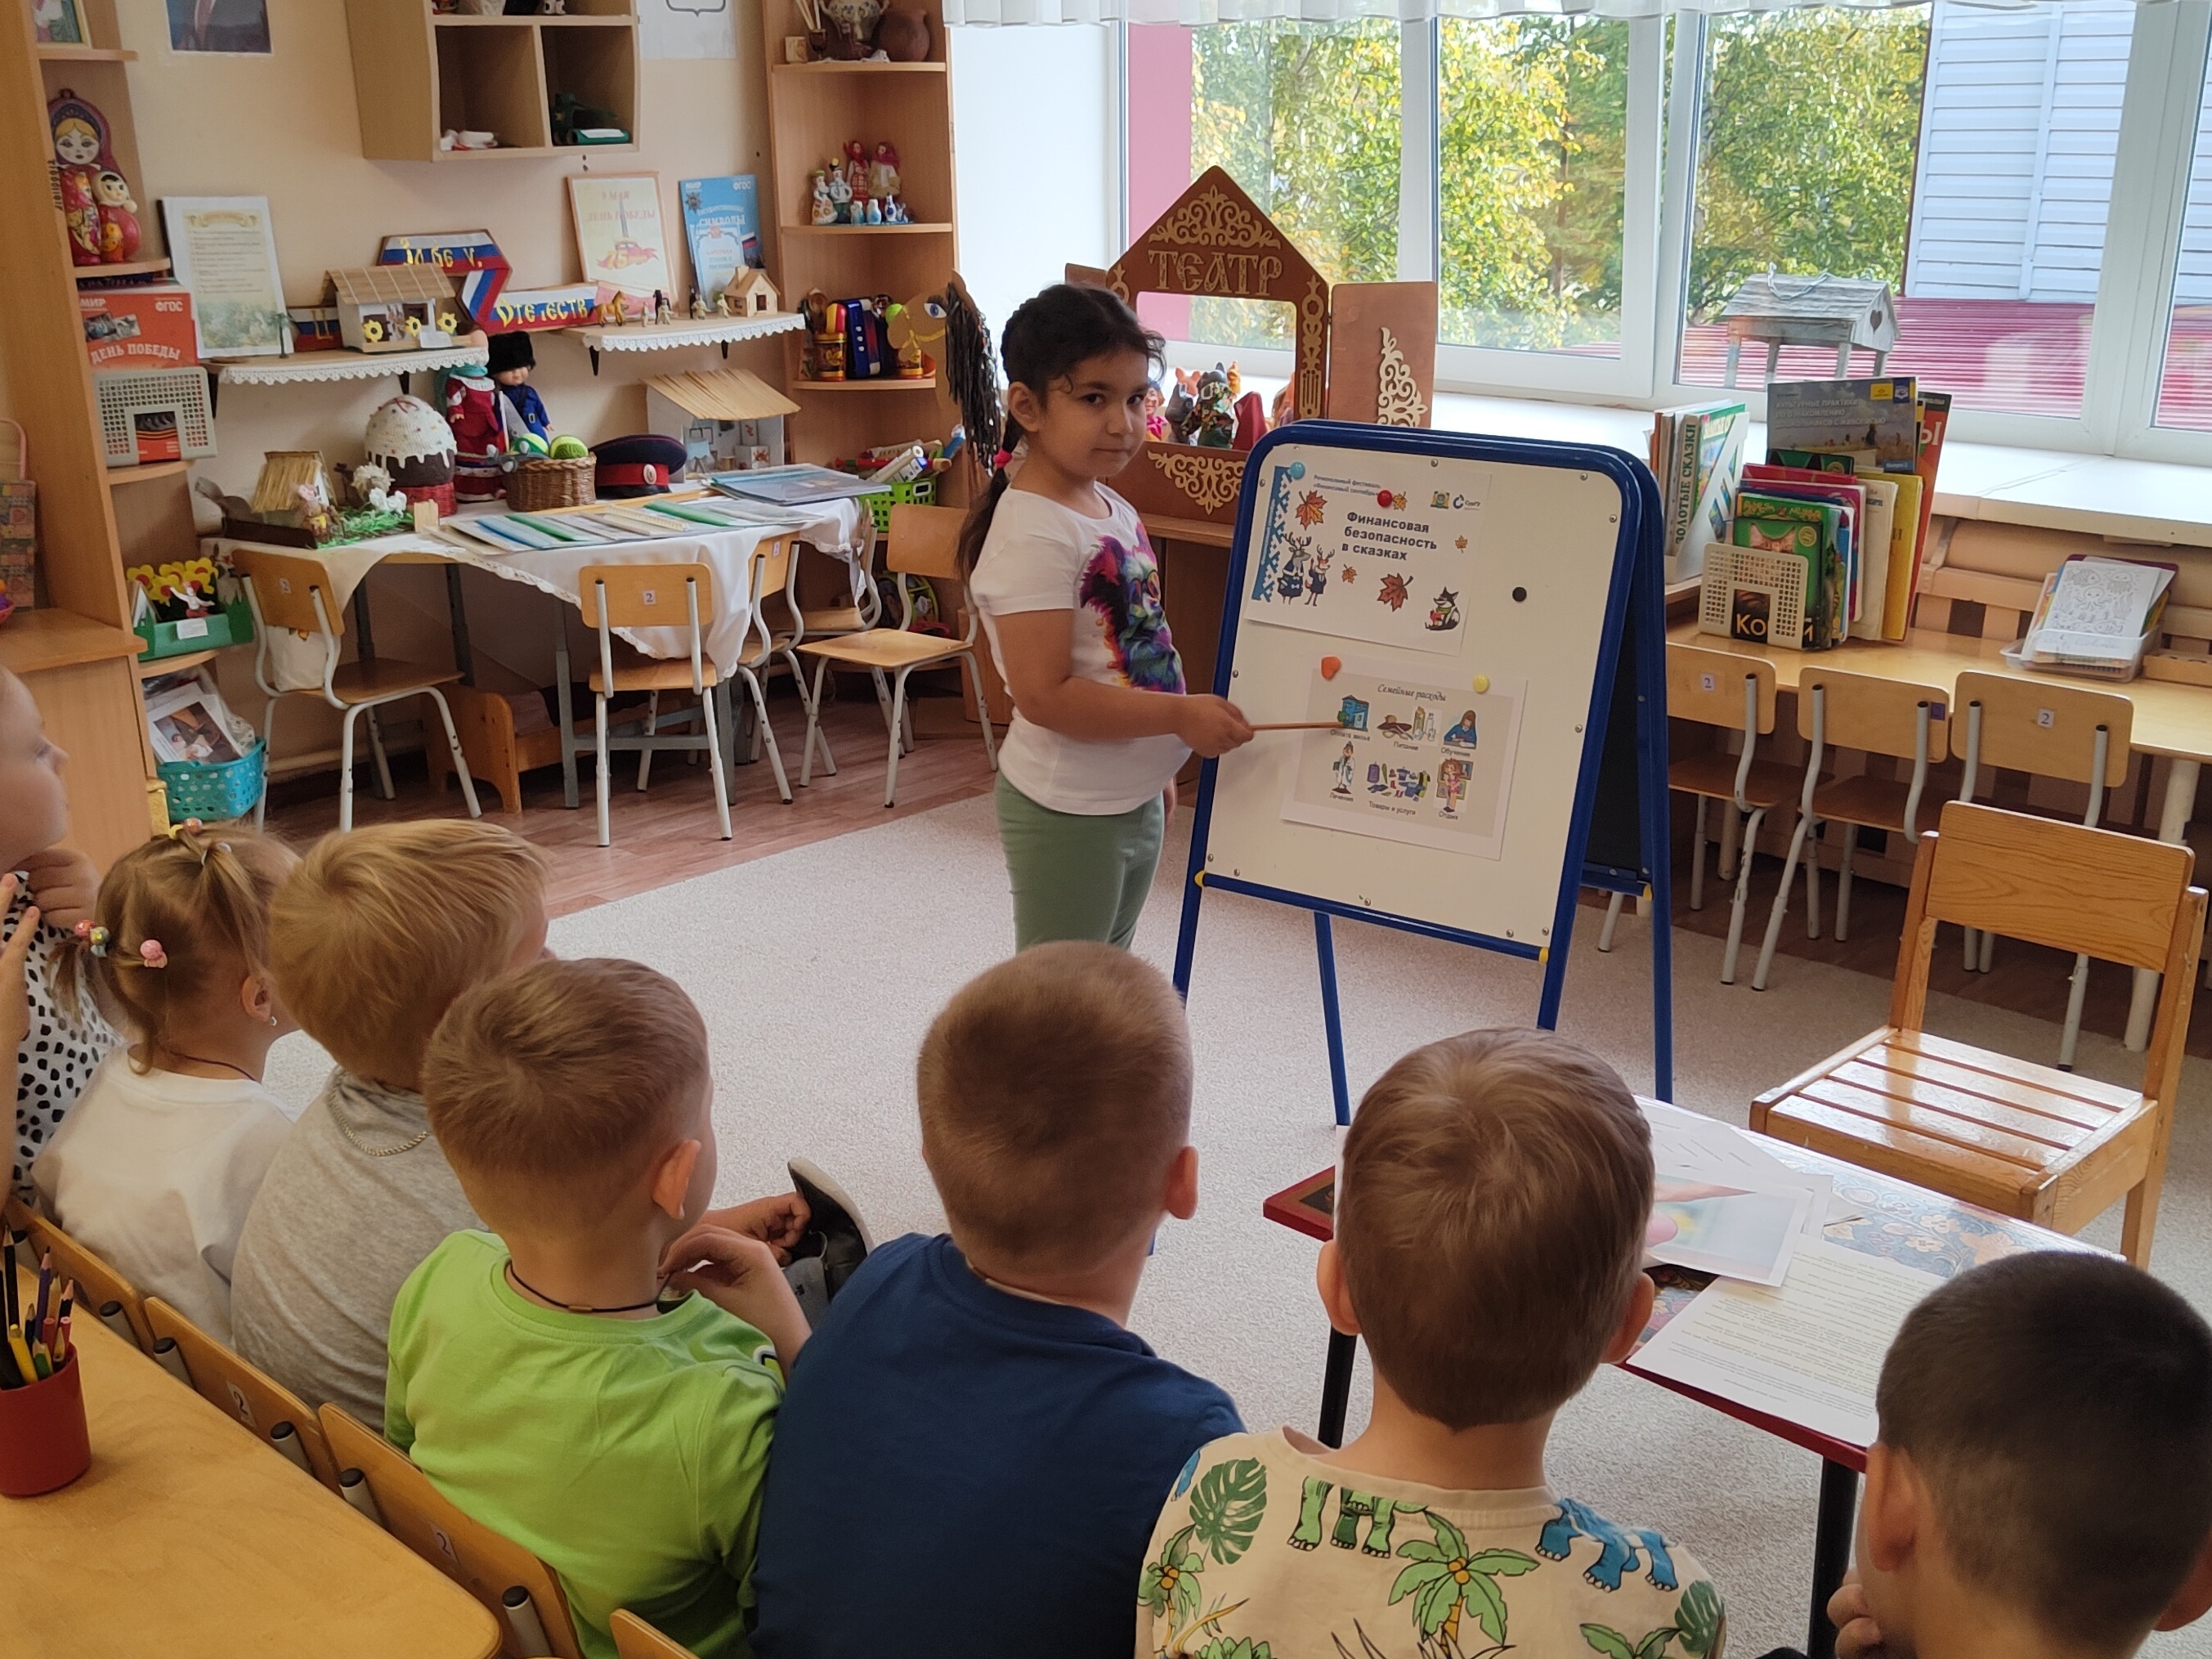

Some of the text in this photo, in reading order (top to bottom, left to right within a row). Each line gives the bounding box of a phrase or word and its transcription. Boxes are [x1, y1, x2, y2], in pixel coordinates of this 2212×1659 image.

[700, 214, 746, 225] СИМВОЛЫ
[1147, 249, 1283, 296] ТЕАТР
[155, 301, 184, 312] ФГОС
[91, 343, 181, 366] ДЕНЬ ПОБЕДЫ
[1676, 424, 1696, 545] ЗОЛОТЫЕ СКАЗКИ
[1347, 512, 1430, 533] Финансовая
[1344, 526, 1437, 549] безопасность
[1341, 543, 1408, 561] в сказках
[646, 593, 653, 603] 2
[1704, 677, 1712, 688] 2
[2040, 713, 2049, 724] 2
[1393, 741, 1418, 751] Питание
[1440, 747, 1471, 758] Обучение
[1329, 792, 1354, 803] Лечение
[1368, 800, 1390, 811] Товары
[1396, 807, 1416, 816] услуги
[1438, 810, 1458, 821] Отдых
[233, 1391, 249, 1415] 2
[437, 1532, 450, 1555] 2
